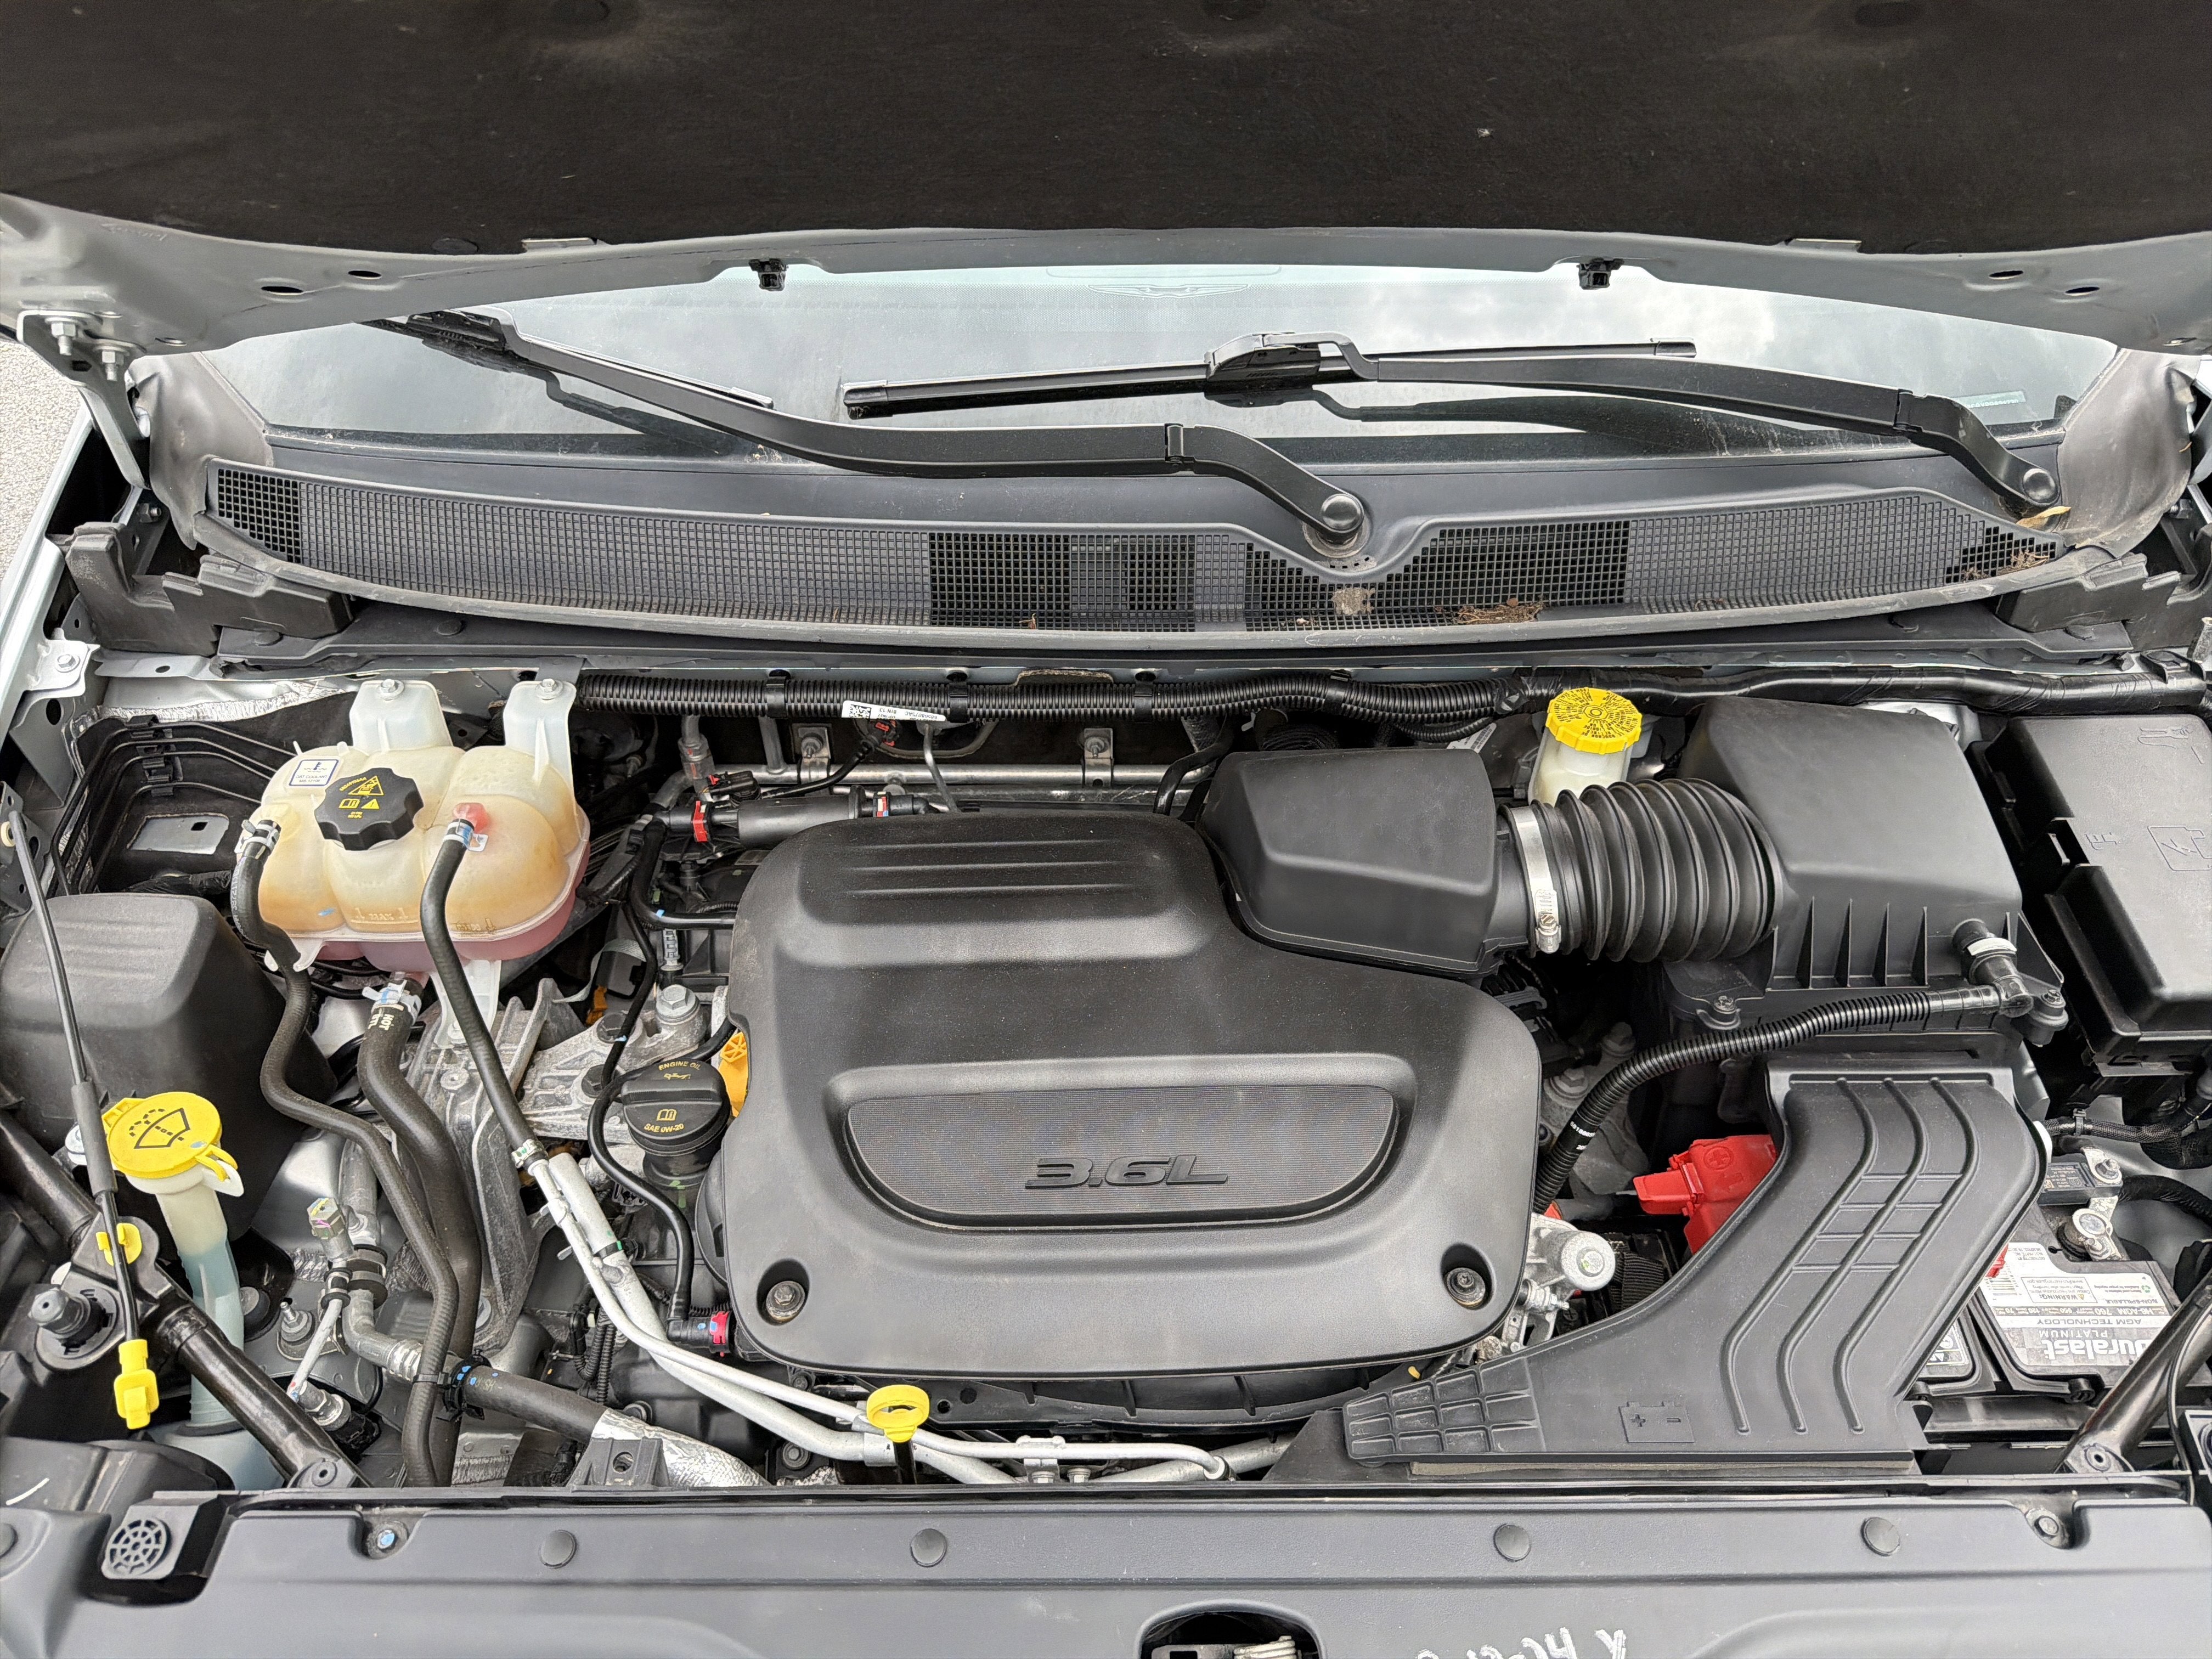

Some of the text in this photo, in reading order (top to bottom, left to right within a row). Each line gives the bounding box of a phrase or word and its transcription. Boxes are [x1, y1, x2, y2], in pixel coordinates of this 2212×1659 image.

[379, 1014, 394, 1031] HOT
[658, 1061, 689, 1070] ENGINE
[644, 1123, 684, 1132] SAE 0W-20
[1025, 1155, 1229, 1189] 3.6L
[2038, 1329, 2108, 1338] PLATINUM
